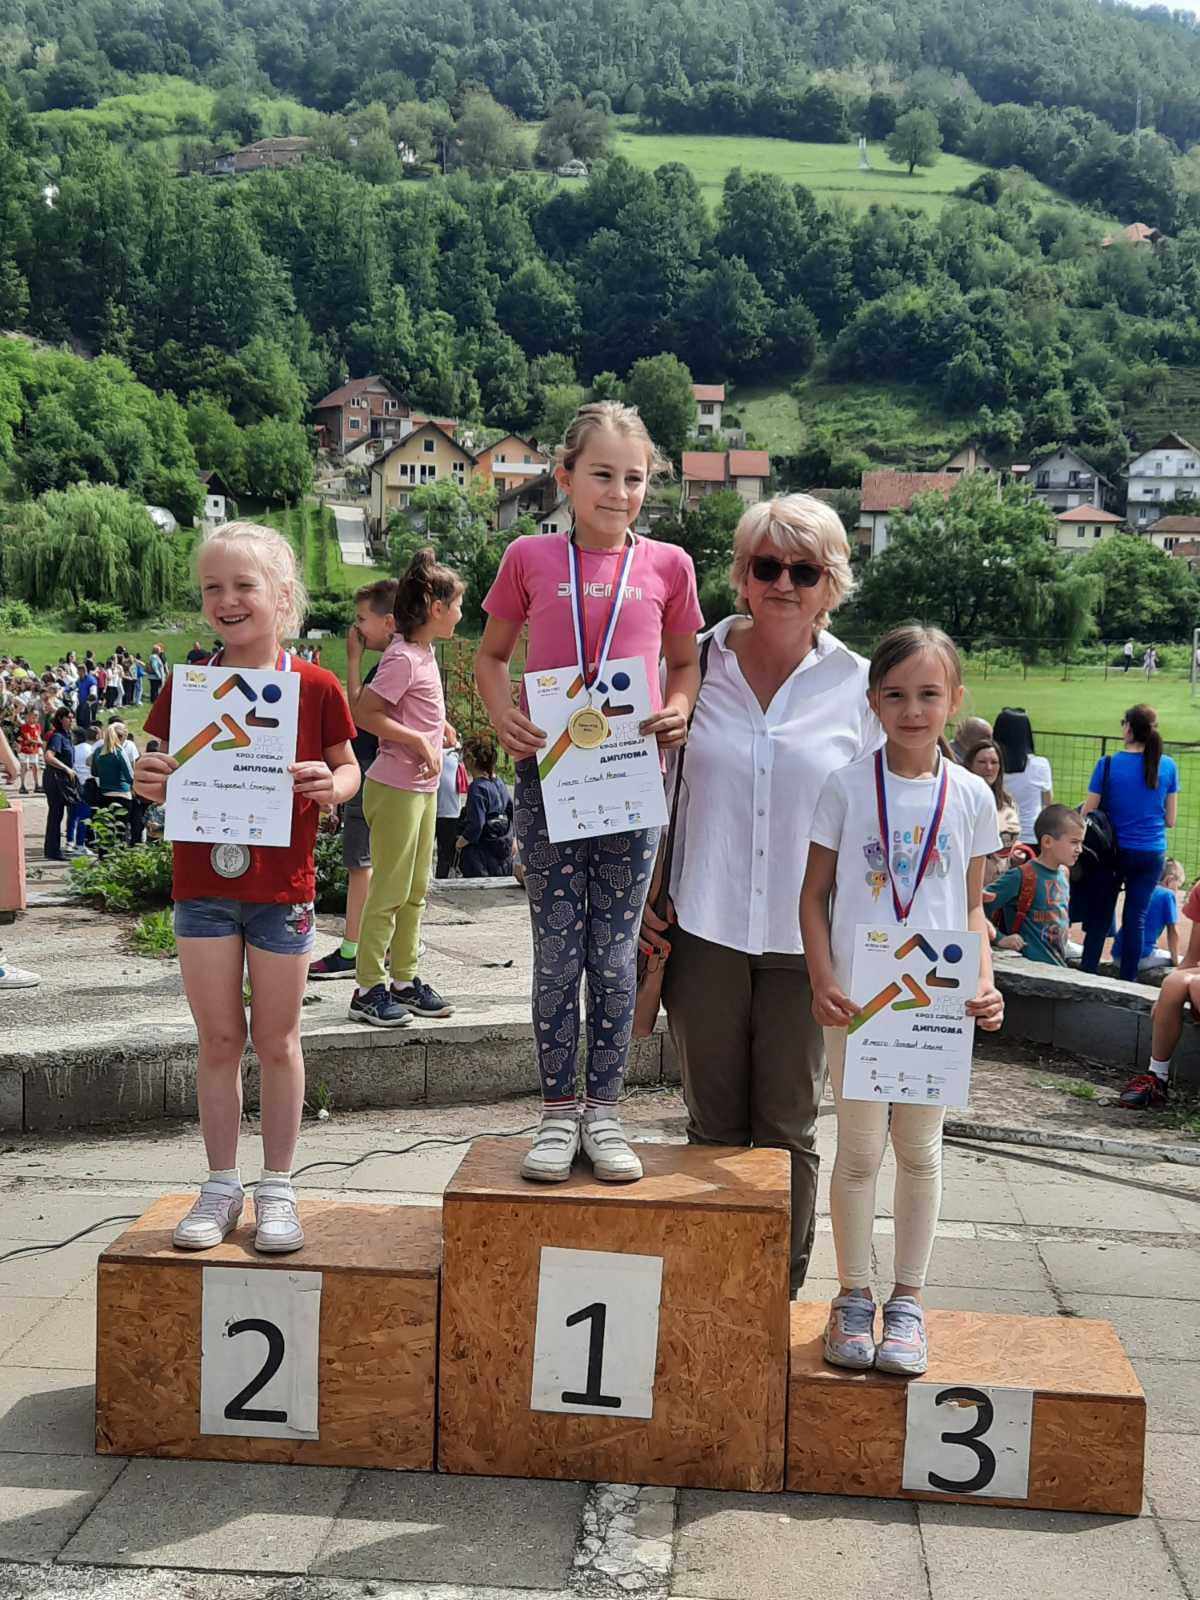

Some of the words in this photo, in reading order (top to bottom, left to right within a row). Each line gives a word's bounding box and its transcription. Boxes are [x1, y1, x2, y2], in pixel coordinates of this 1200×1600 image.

[233, 764, 283, 774] ДИПЛОМА
[600, 750, 648, 764] ДИПЛОМА
[911, 1024, 963, 1035] ДИПЛОМА
[224, 1318, 288, 1423] 2
[561, 1302, 622, 1409] 1
[927, 1386, 996, 1494] 3
